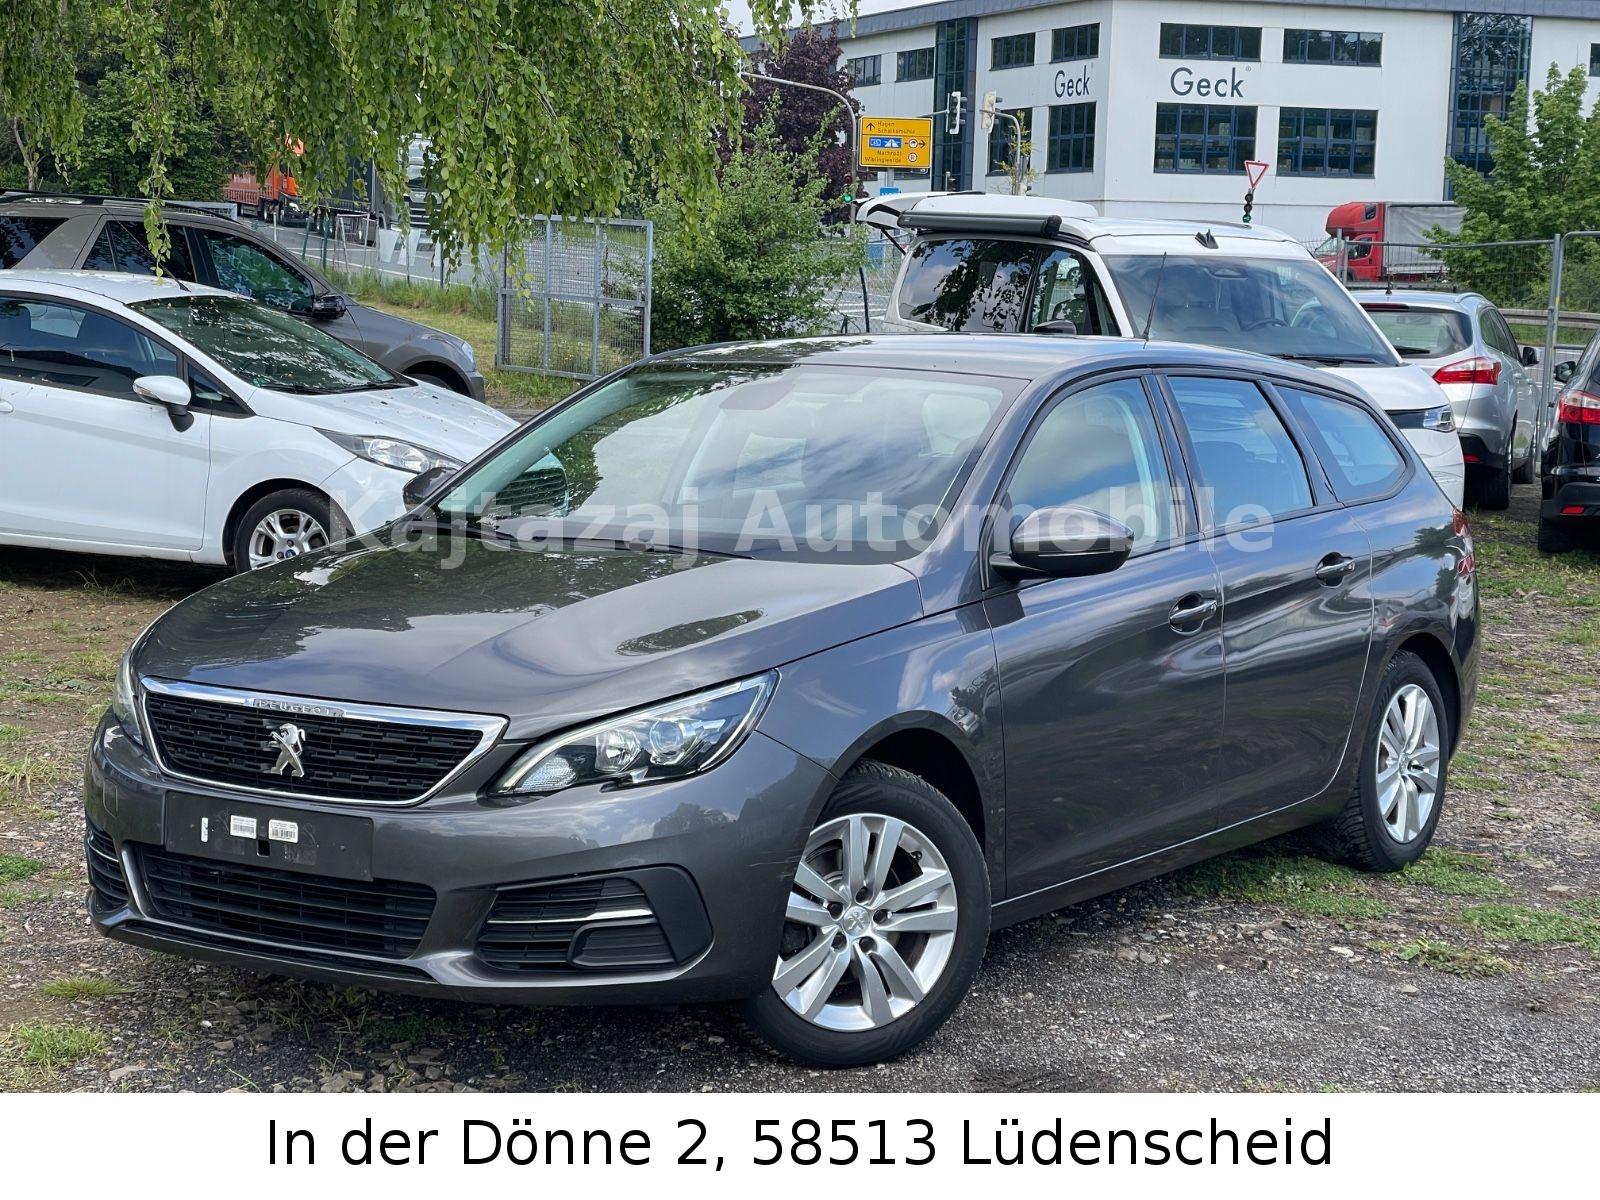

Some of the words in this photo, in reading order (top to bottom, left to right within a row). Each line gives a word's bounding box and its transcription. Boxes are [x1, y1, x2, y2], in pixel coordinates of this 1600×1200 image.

[1054, 65, 1090, 98] Geck
[1170, 67, 1245, 98] Geck
[259, 700, 330, 715] PEUGEOT
